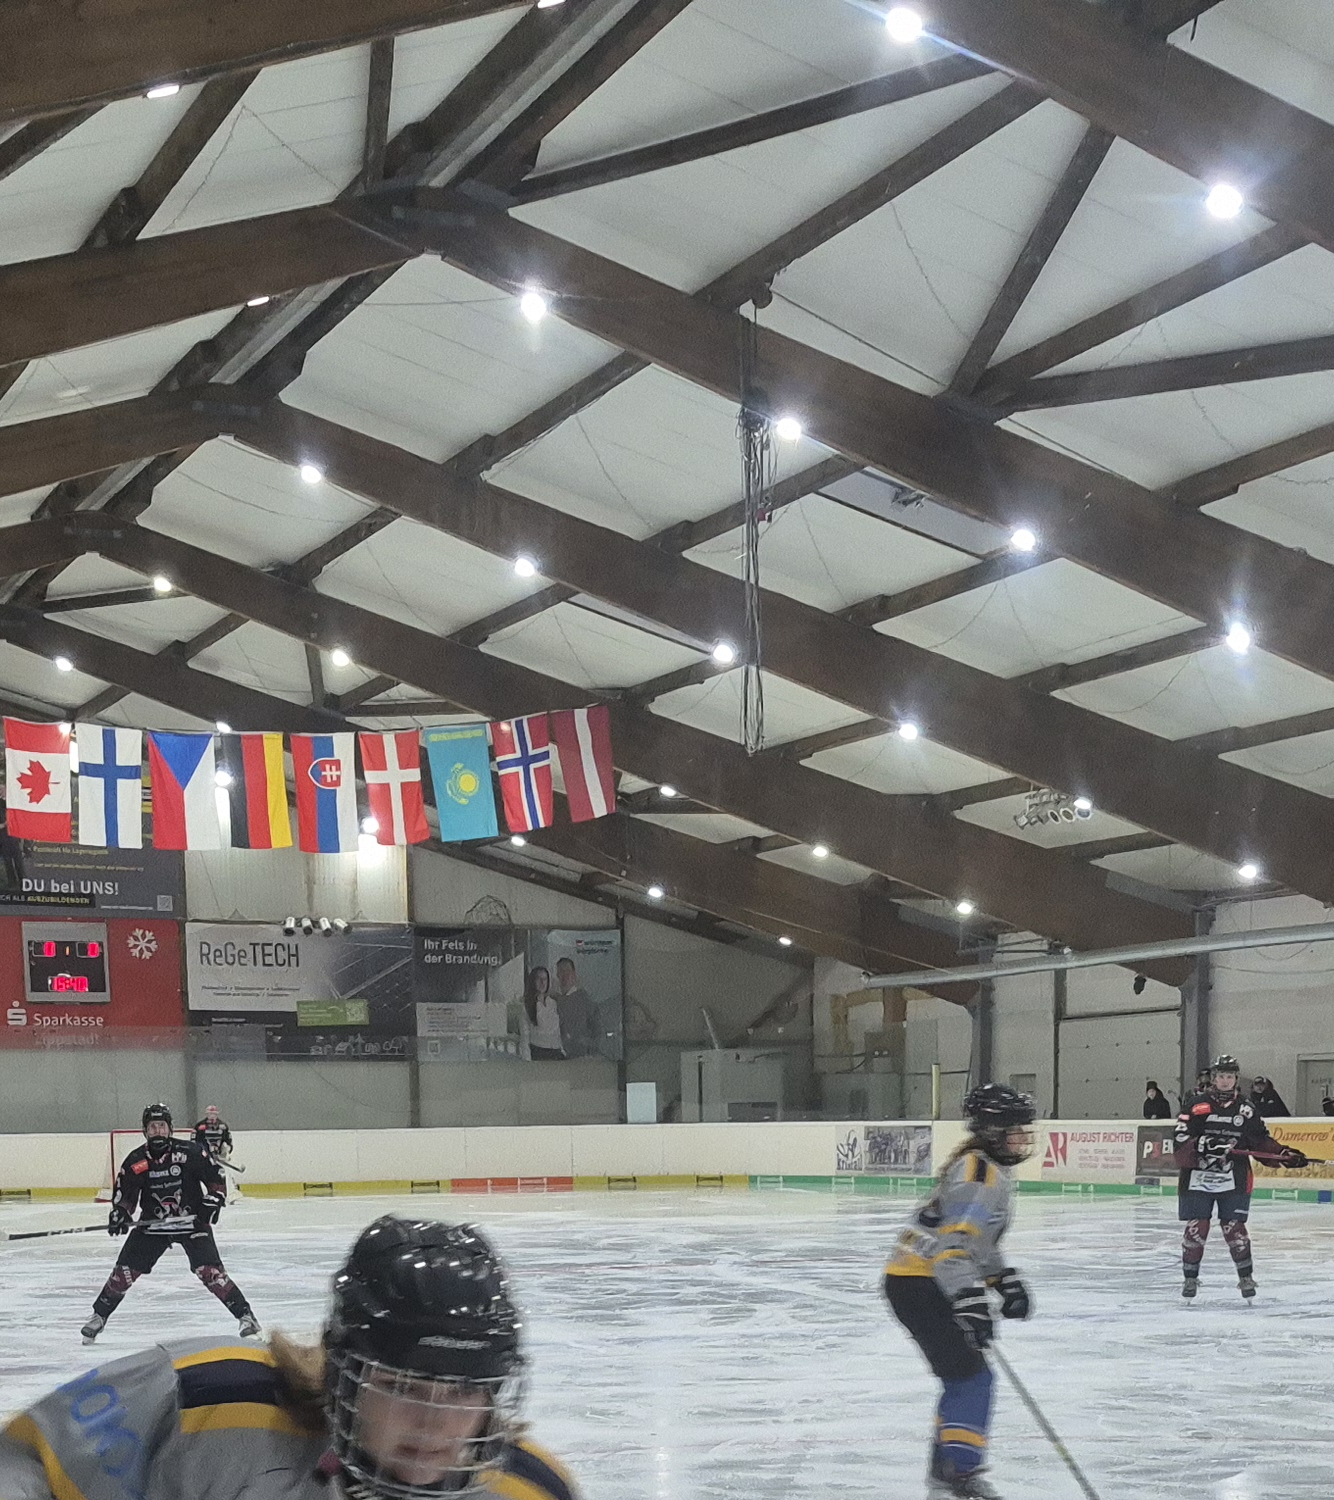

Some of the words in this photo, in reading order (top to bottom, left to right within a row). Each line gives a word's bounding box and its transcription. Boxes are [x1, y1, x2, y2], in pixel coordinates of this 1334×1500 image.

[22, 878, 44, 892] DU
[51, 879, 75, 893] bei
[80, 881, 119, 895] UNS!
[424, 939, 440, 950] Ihr
[442, 939, 464, 951] Fels
[199, 941, 300, 968] ReGeTECH
[424, 953, 444, 964] der
[445, 953, 502, 966] Brandung.
[33, 1013, 104, 1028] Sparkasse
[1070, 1131, 1101, 1143] AUGUST
[1102, 1131, 1135, 1143] RICHTER
